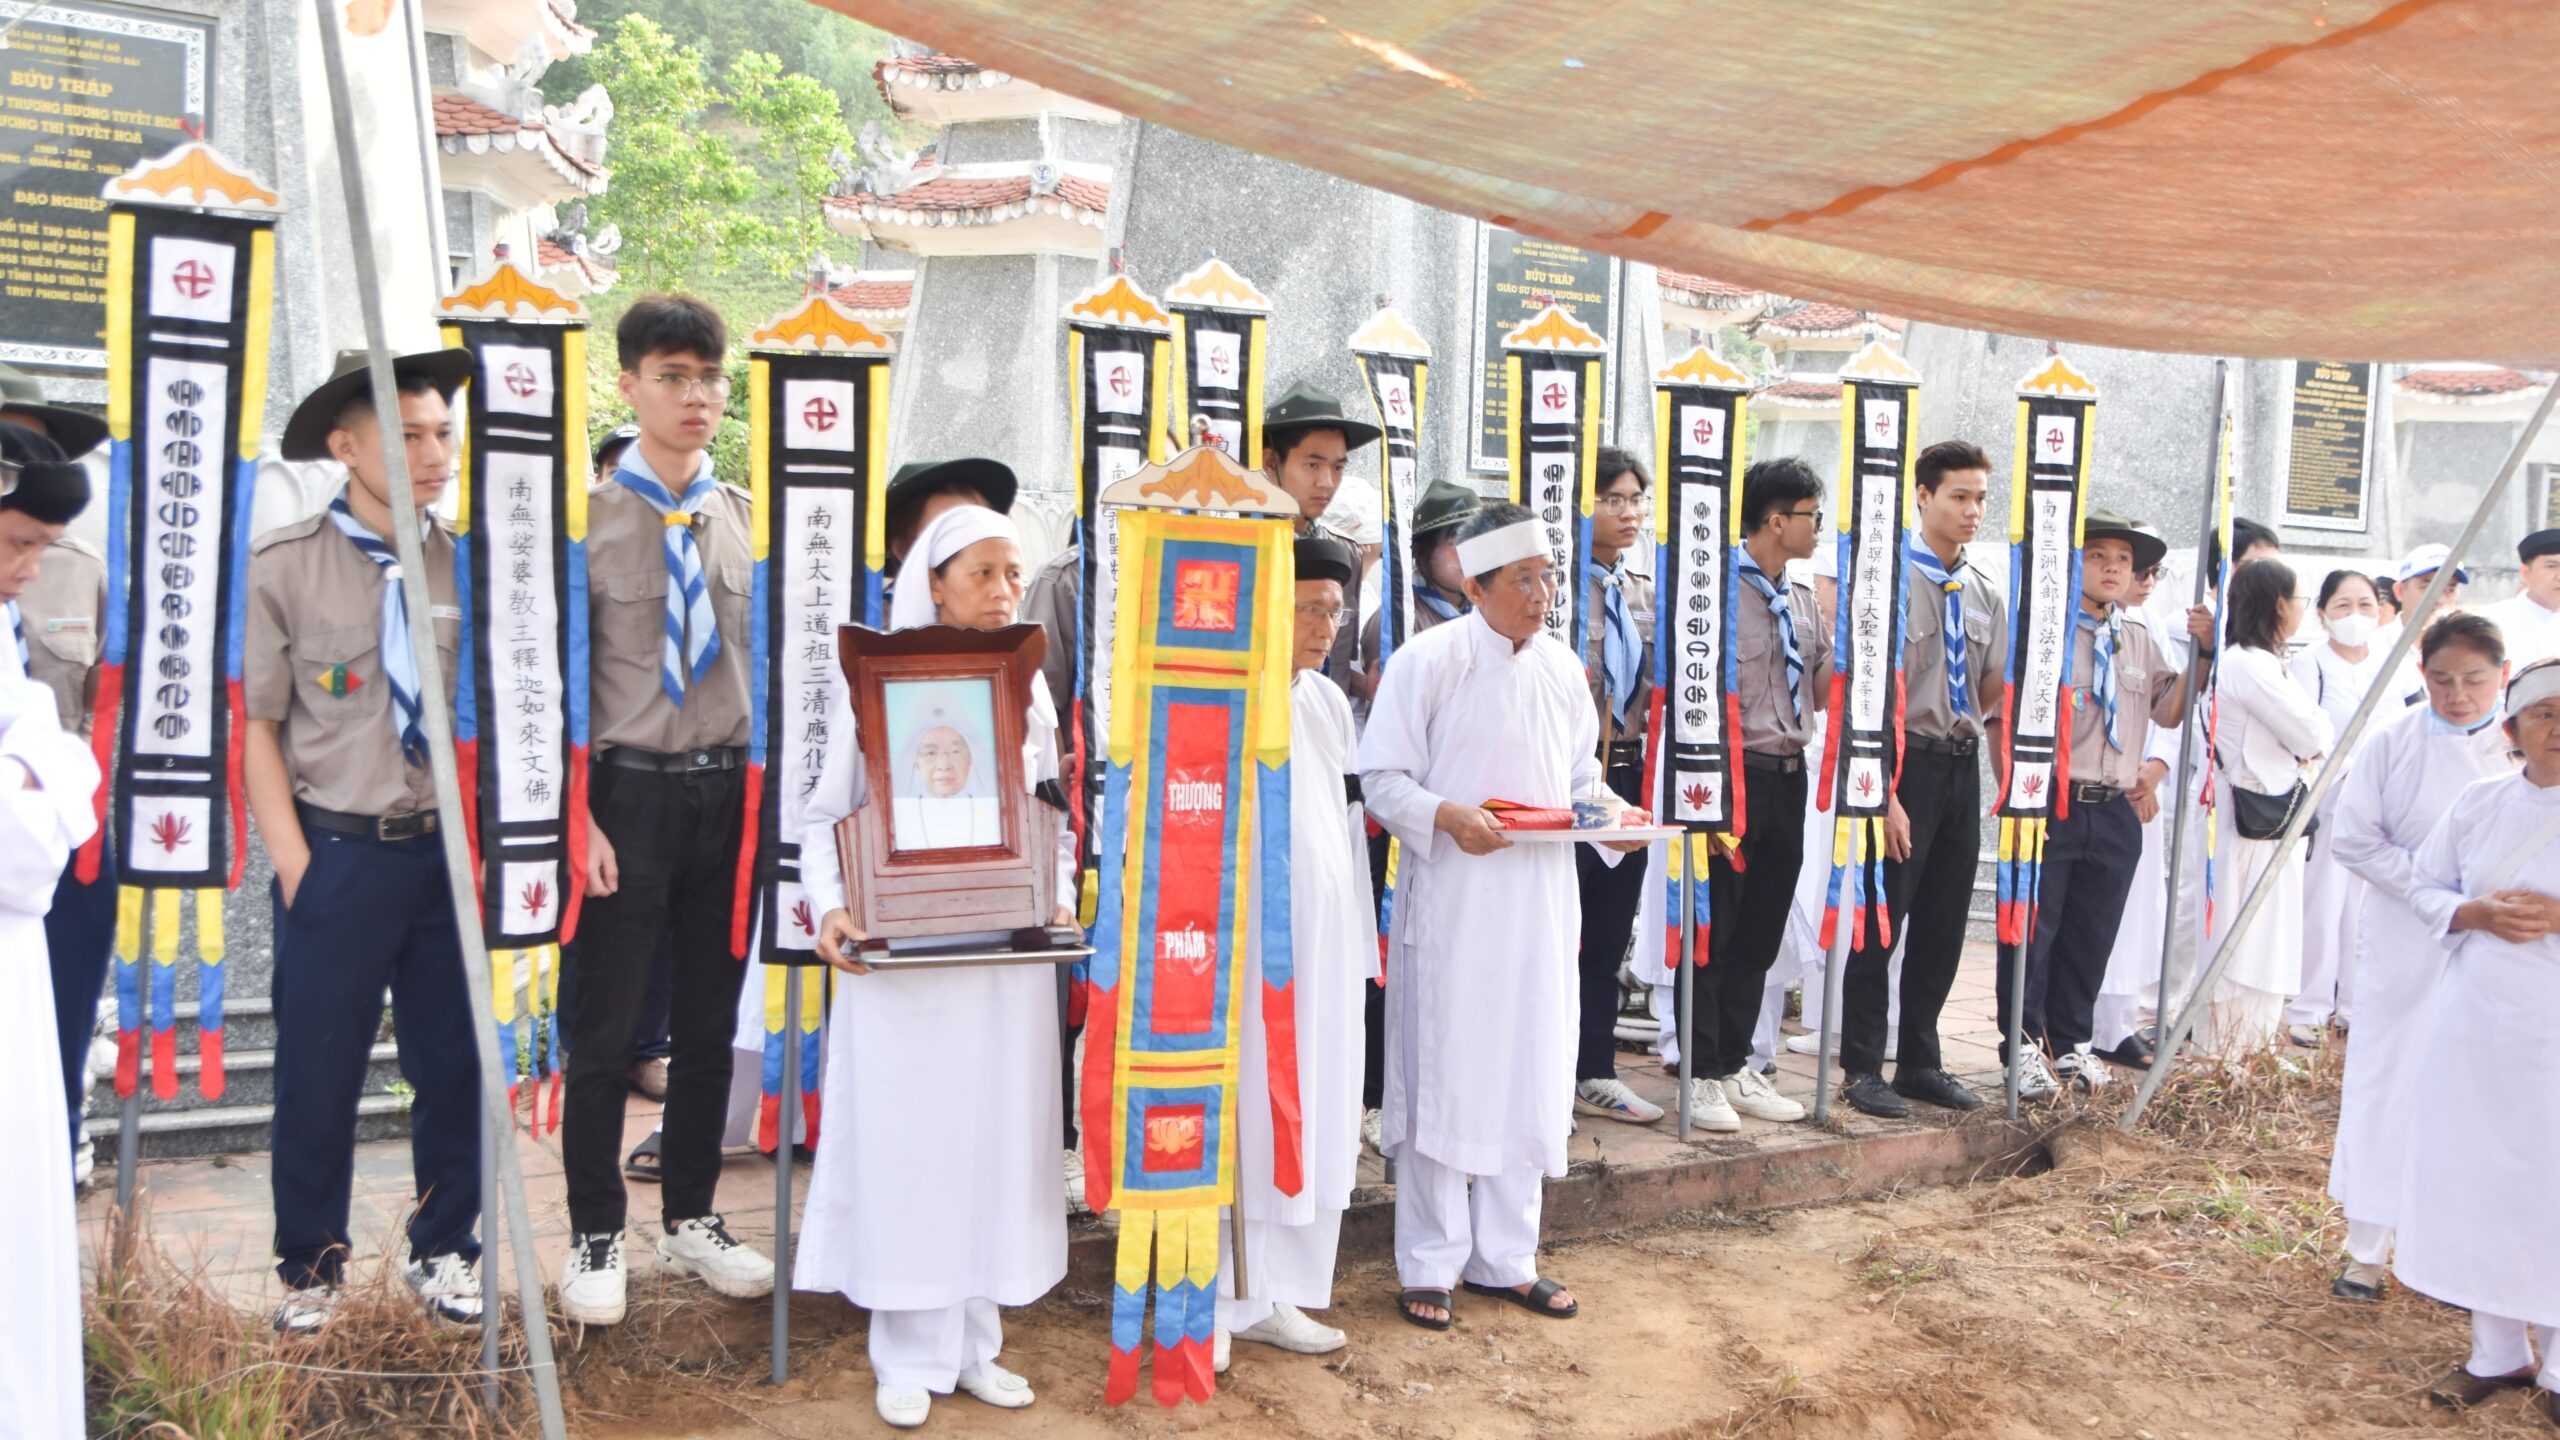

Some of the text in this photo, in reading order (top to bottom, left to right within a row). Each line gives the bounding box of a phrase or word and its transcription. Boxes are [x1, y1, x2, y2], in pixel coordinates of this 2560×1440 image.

[59, 76, 113, 97] THÁP
[113, 129, 143, 144] HOA
[14, 189, 108, 213] ĐẠO NGHIỆP
[35, 288, 71, 301] PHONG
[167, 379, 205, 408] NAM
[1543, 464, 1566, 483] NAM
[1694, 501, 1711, 521] NAM
[801, 506, 835, 804] 南無太上道祖三清應化天
[1687, 641, 1710, 658] A
[1168, 781, 1222, 815] THƯỢNG
[1165, 921, 1206, 959] PHẨM
